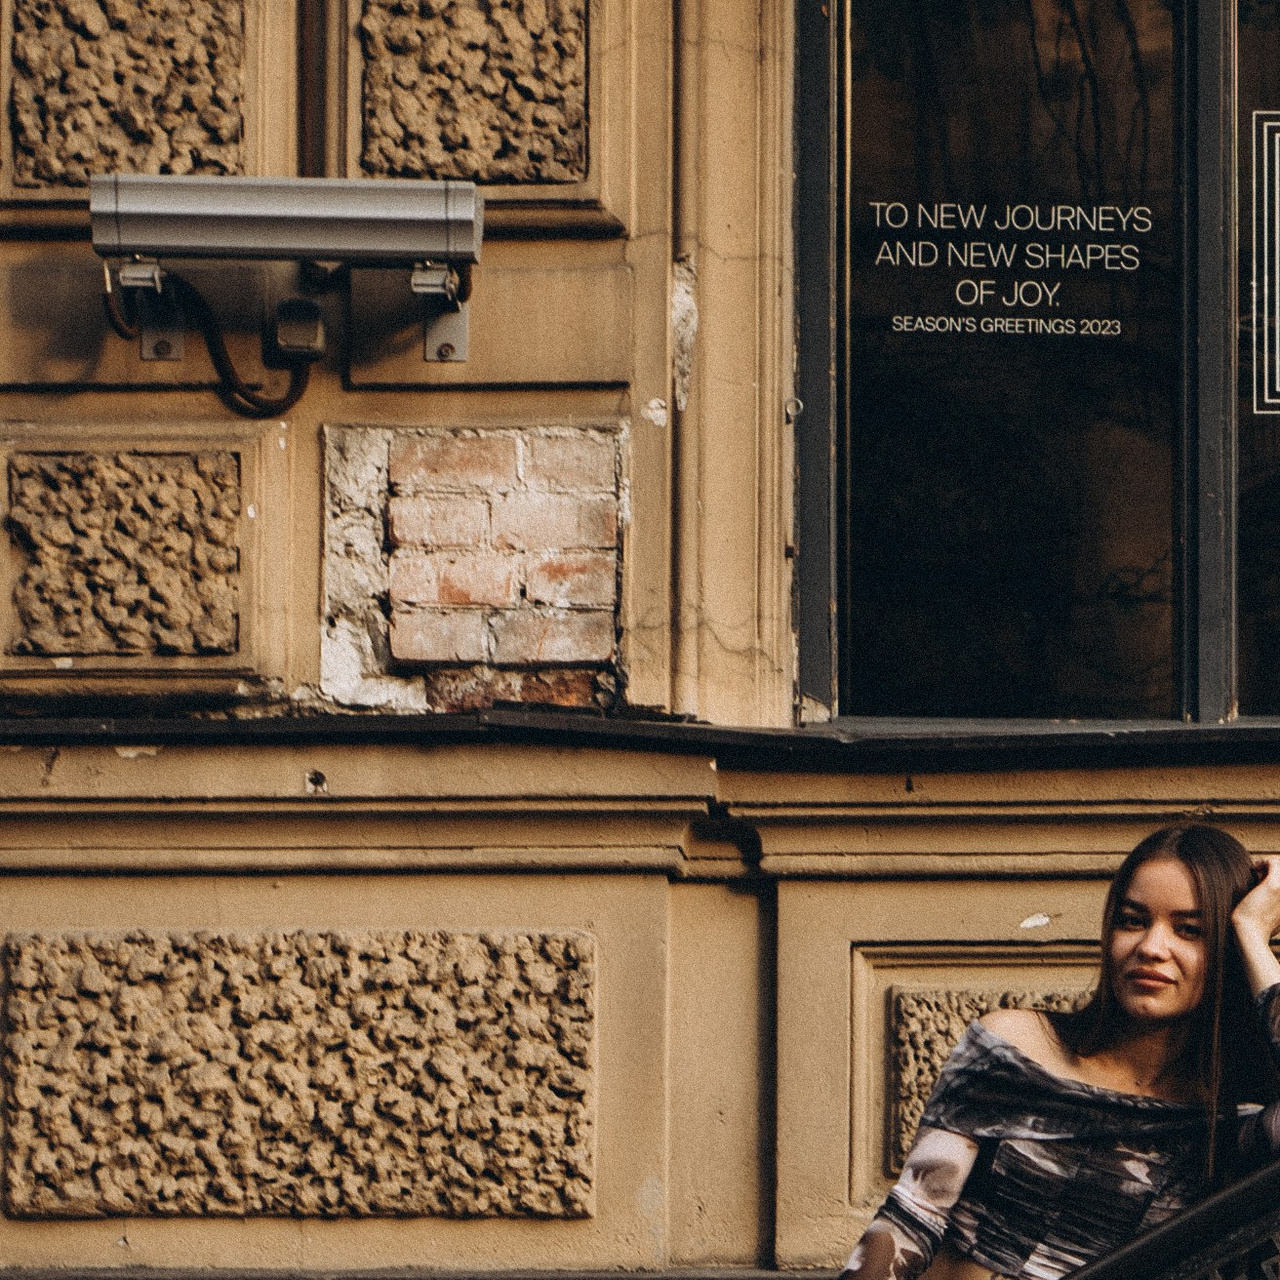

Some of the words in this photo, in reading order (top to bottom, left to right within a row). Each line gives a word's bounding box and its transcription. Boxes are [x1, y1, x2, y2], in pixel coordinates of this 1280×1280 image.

[869, 201, 909, 229] TO
[917, 202, 987, 229] NEW
[994, 204, 1153, 233] JOURNEYS
[875, 241, 939, 267] AND
[947, 241, 1017, 268] NEW
[1024, 242, 1140, 271] SHAPES
[955, 278, 996, 306] OF
[1001, 280, 1062, 308] JOY.
[892, 315, 977, 333] SEASON'S
[980, 317, 1077, 335] GREETINGS
[1079, 319, 1122, 336] 2023
